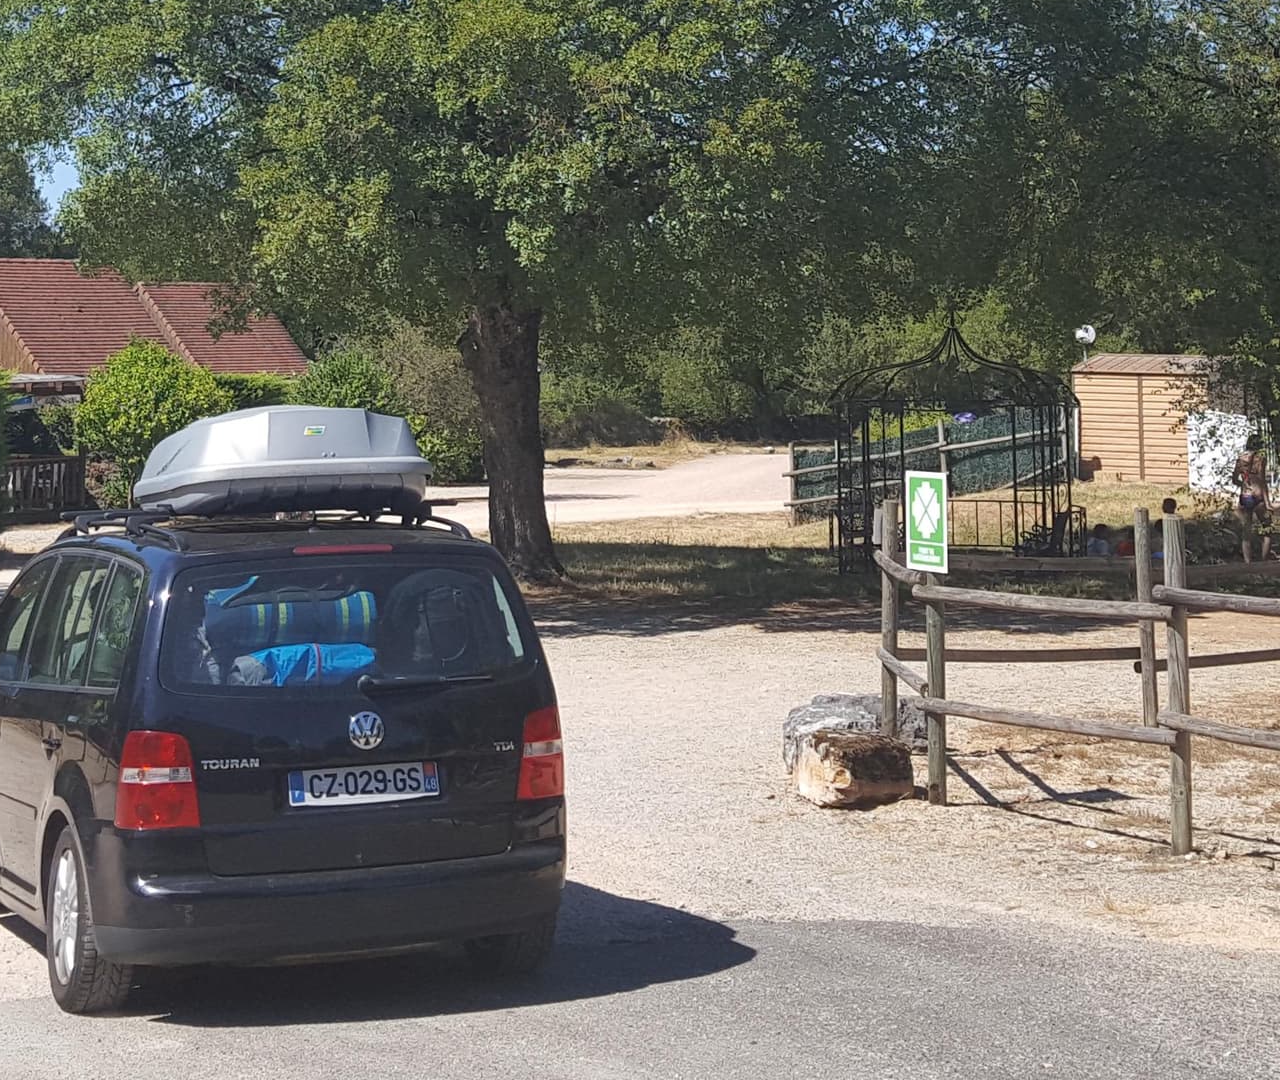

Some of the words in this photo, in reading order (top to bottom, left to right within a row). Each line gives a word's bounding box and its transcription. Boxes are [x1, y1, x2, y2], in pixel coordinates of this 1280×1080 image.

[200, 757, 260, 770] TOURAN
[309, 767, 421, 799] CZ-029-GS
[424, 776, 437, 790] 48
